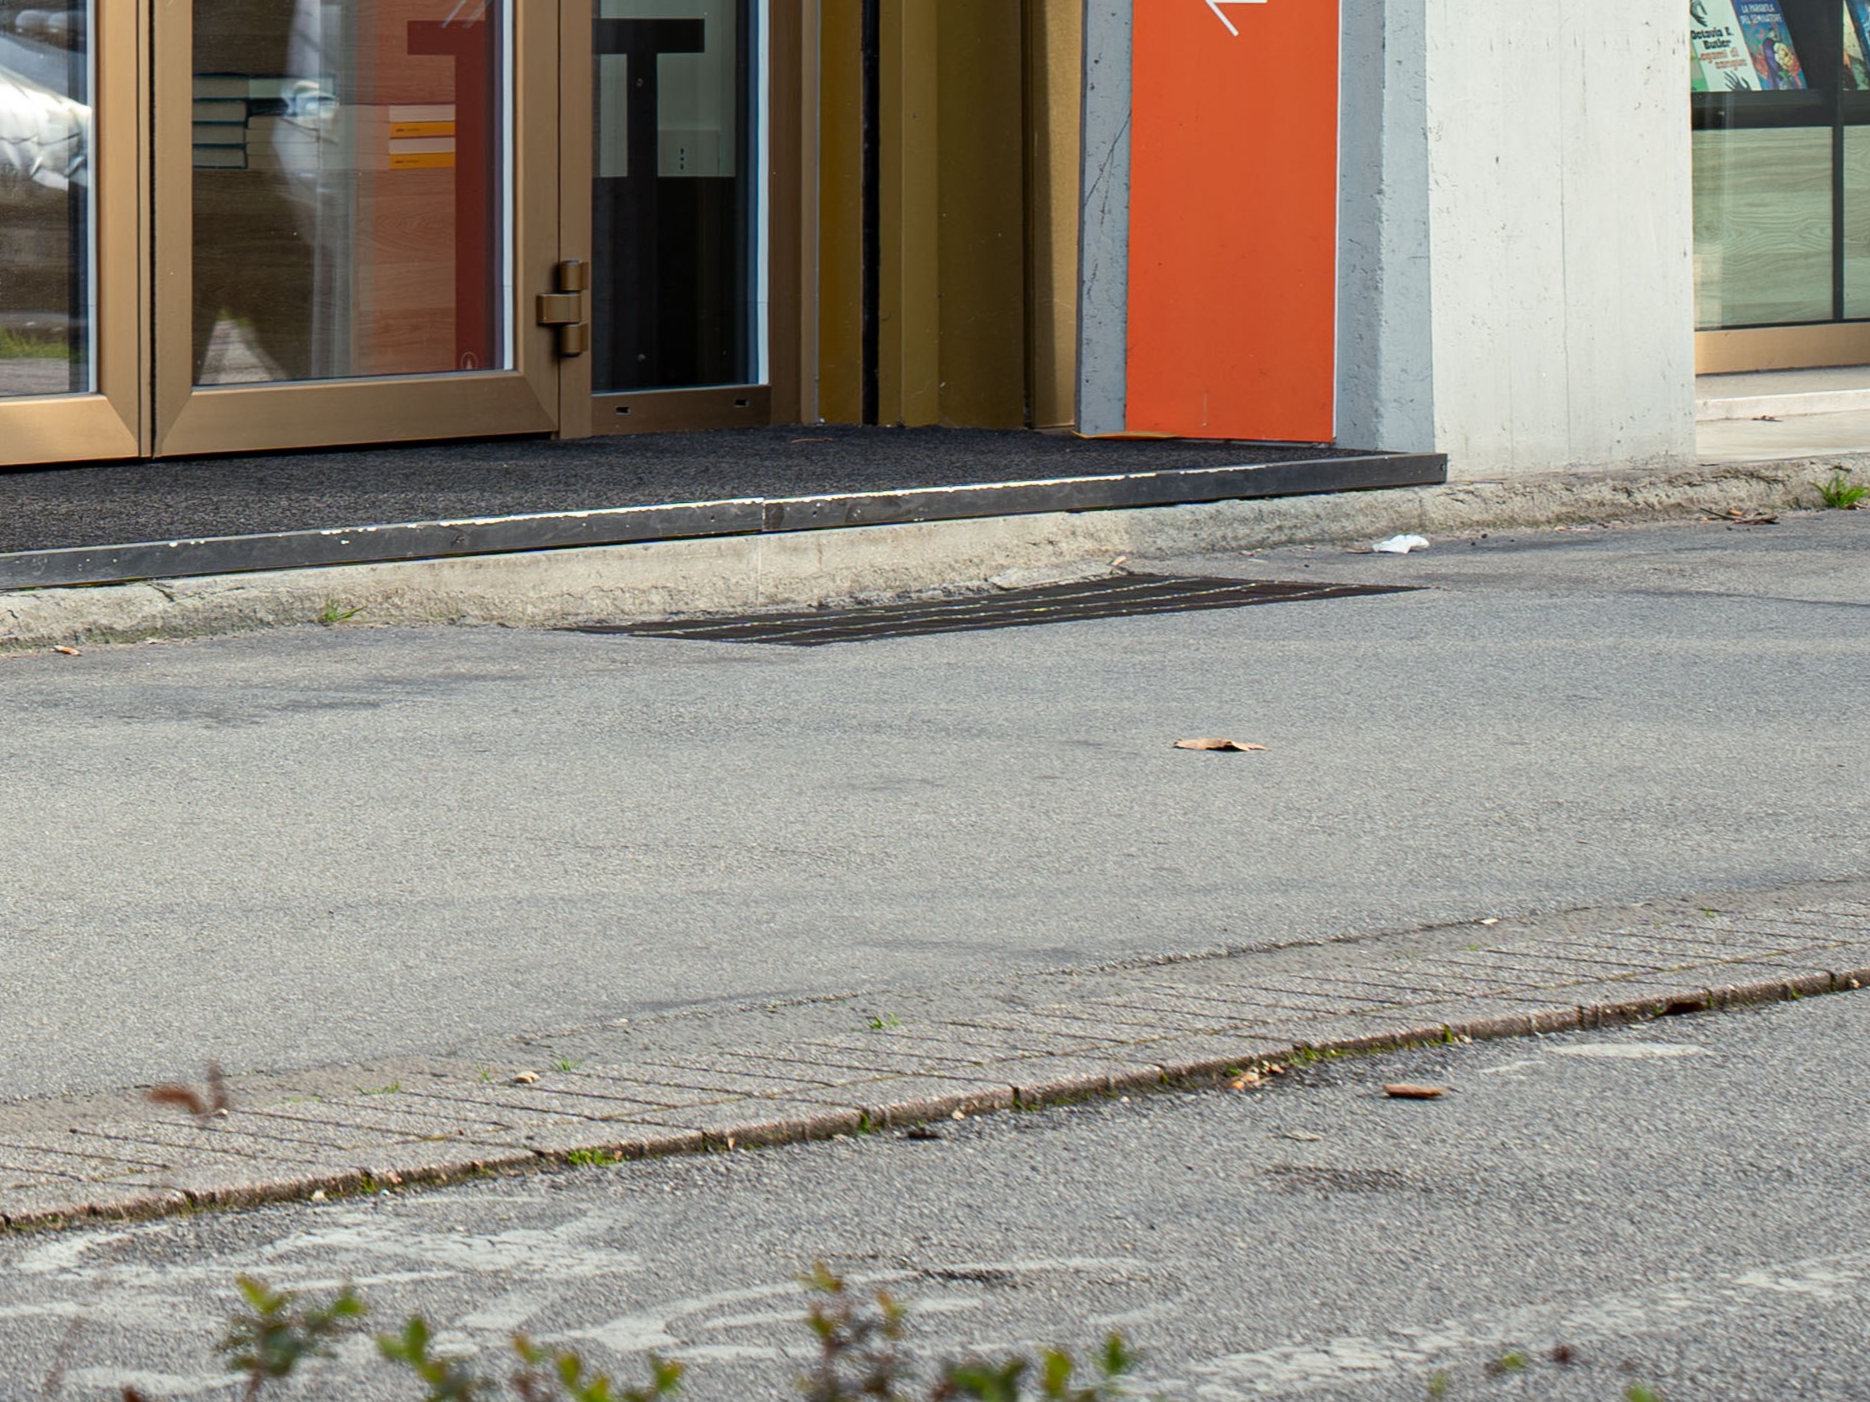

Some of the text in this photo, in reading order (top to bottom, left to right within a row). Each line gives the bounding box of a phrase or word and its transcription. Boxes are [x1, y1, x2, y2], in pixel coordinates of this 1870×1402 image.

[1691, 26, 1735, 41] Octavia E.
[1704, 39, 1732, 51] Butler
